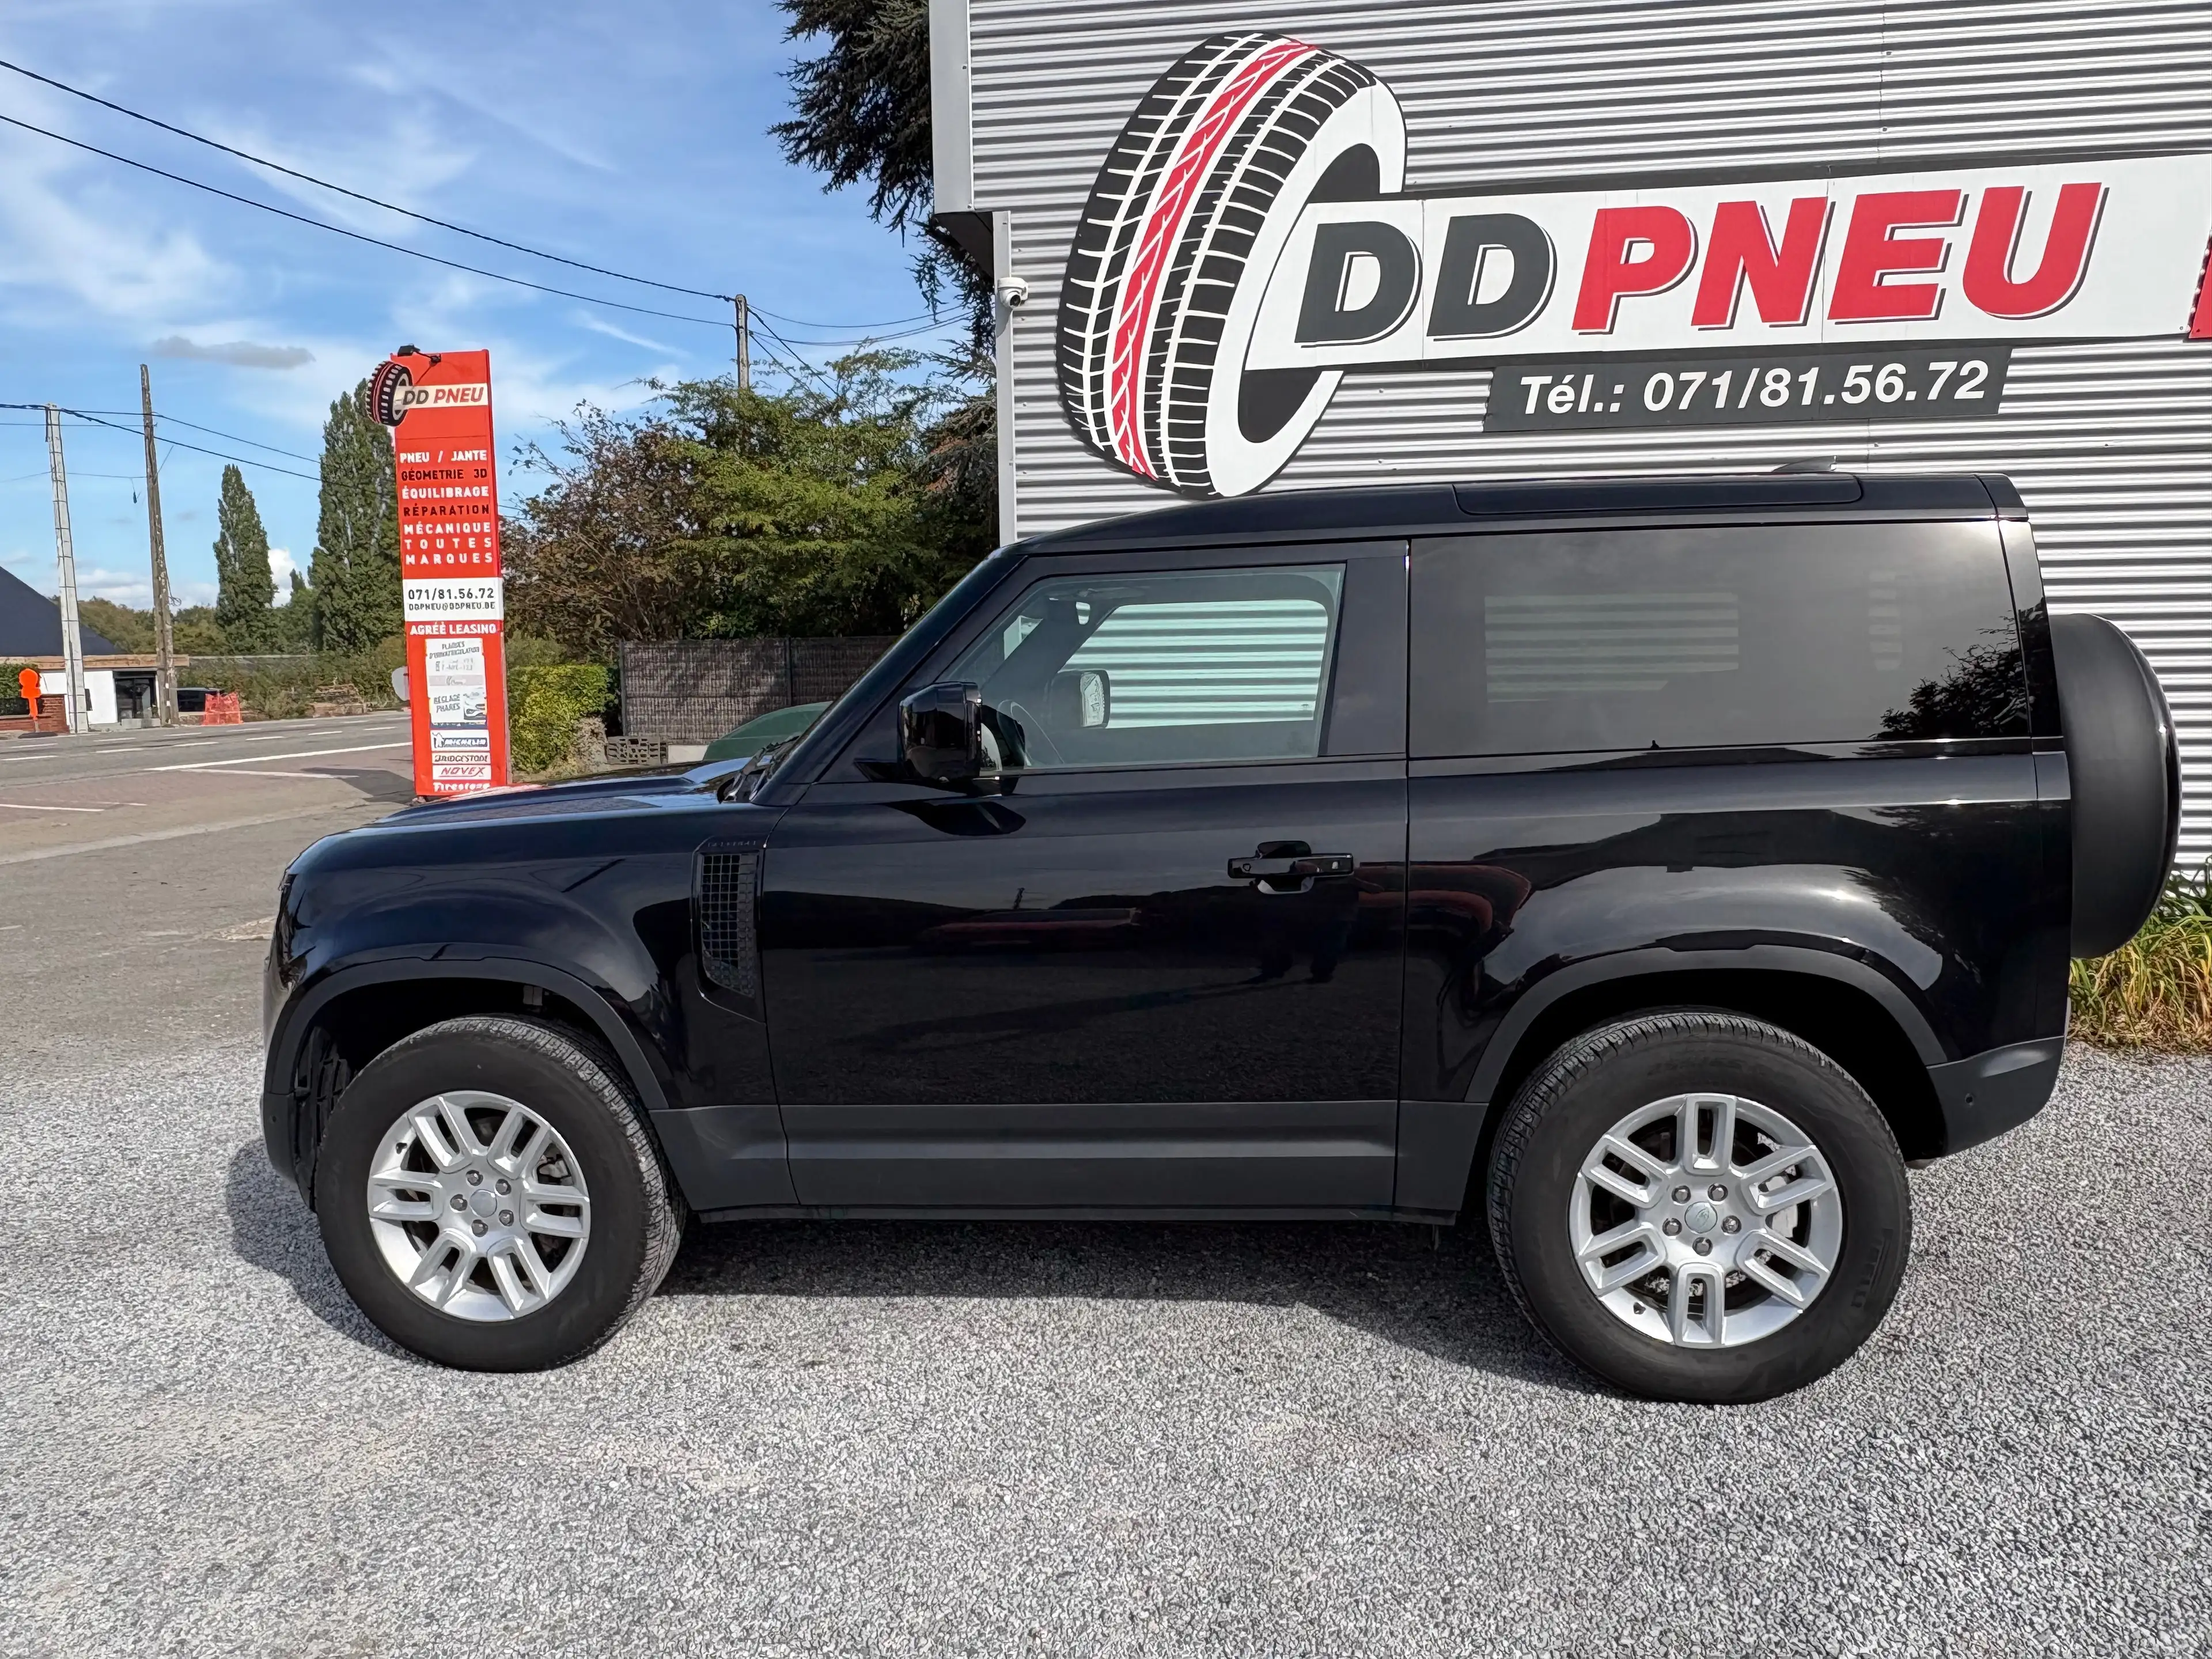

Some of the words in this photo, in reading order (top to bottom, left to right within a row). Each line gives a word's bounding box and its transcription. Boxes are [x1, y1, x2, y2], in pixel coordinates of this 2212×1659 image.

[1294, 213, 1557, 347] DD
[1571, 182, 2109, 335] PNEU
[1520, 374, 1625, 415] Tél.:
[1643, 359, 1989, 411] 071/81.56.72
[403, 390, 429, 405] DD
[433, 387, 484, 404] PNEU
[399, 452, 430, 463] PNEU
[451, 449, 487, 461] JANTE
[401, 467, 464, 481] GÉOMETRIE
[474, 468, 487, 478] 3D
[402, 486, 489, 499] ÉQUILIBRAGE
[403, 503, 489, 516] RÉPARATION
[404, 521, 491, 535] MÉCANIQUE
[404, 537, 492, 550] TOUTES
[406, 552, 493, 565] MARQUES
[408, 588, 494, 600] 071/81.56.72
[449, 623, 496, 634] LEASING
[439, 767, 486, 777] NOVEX
